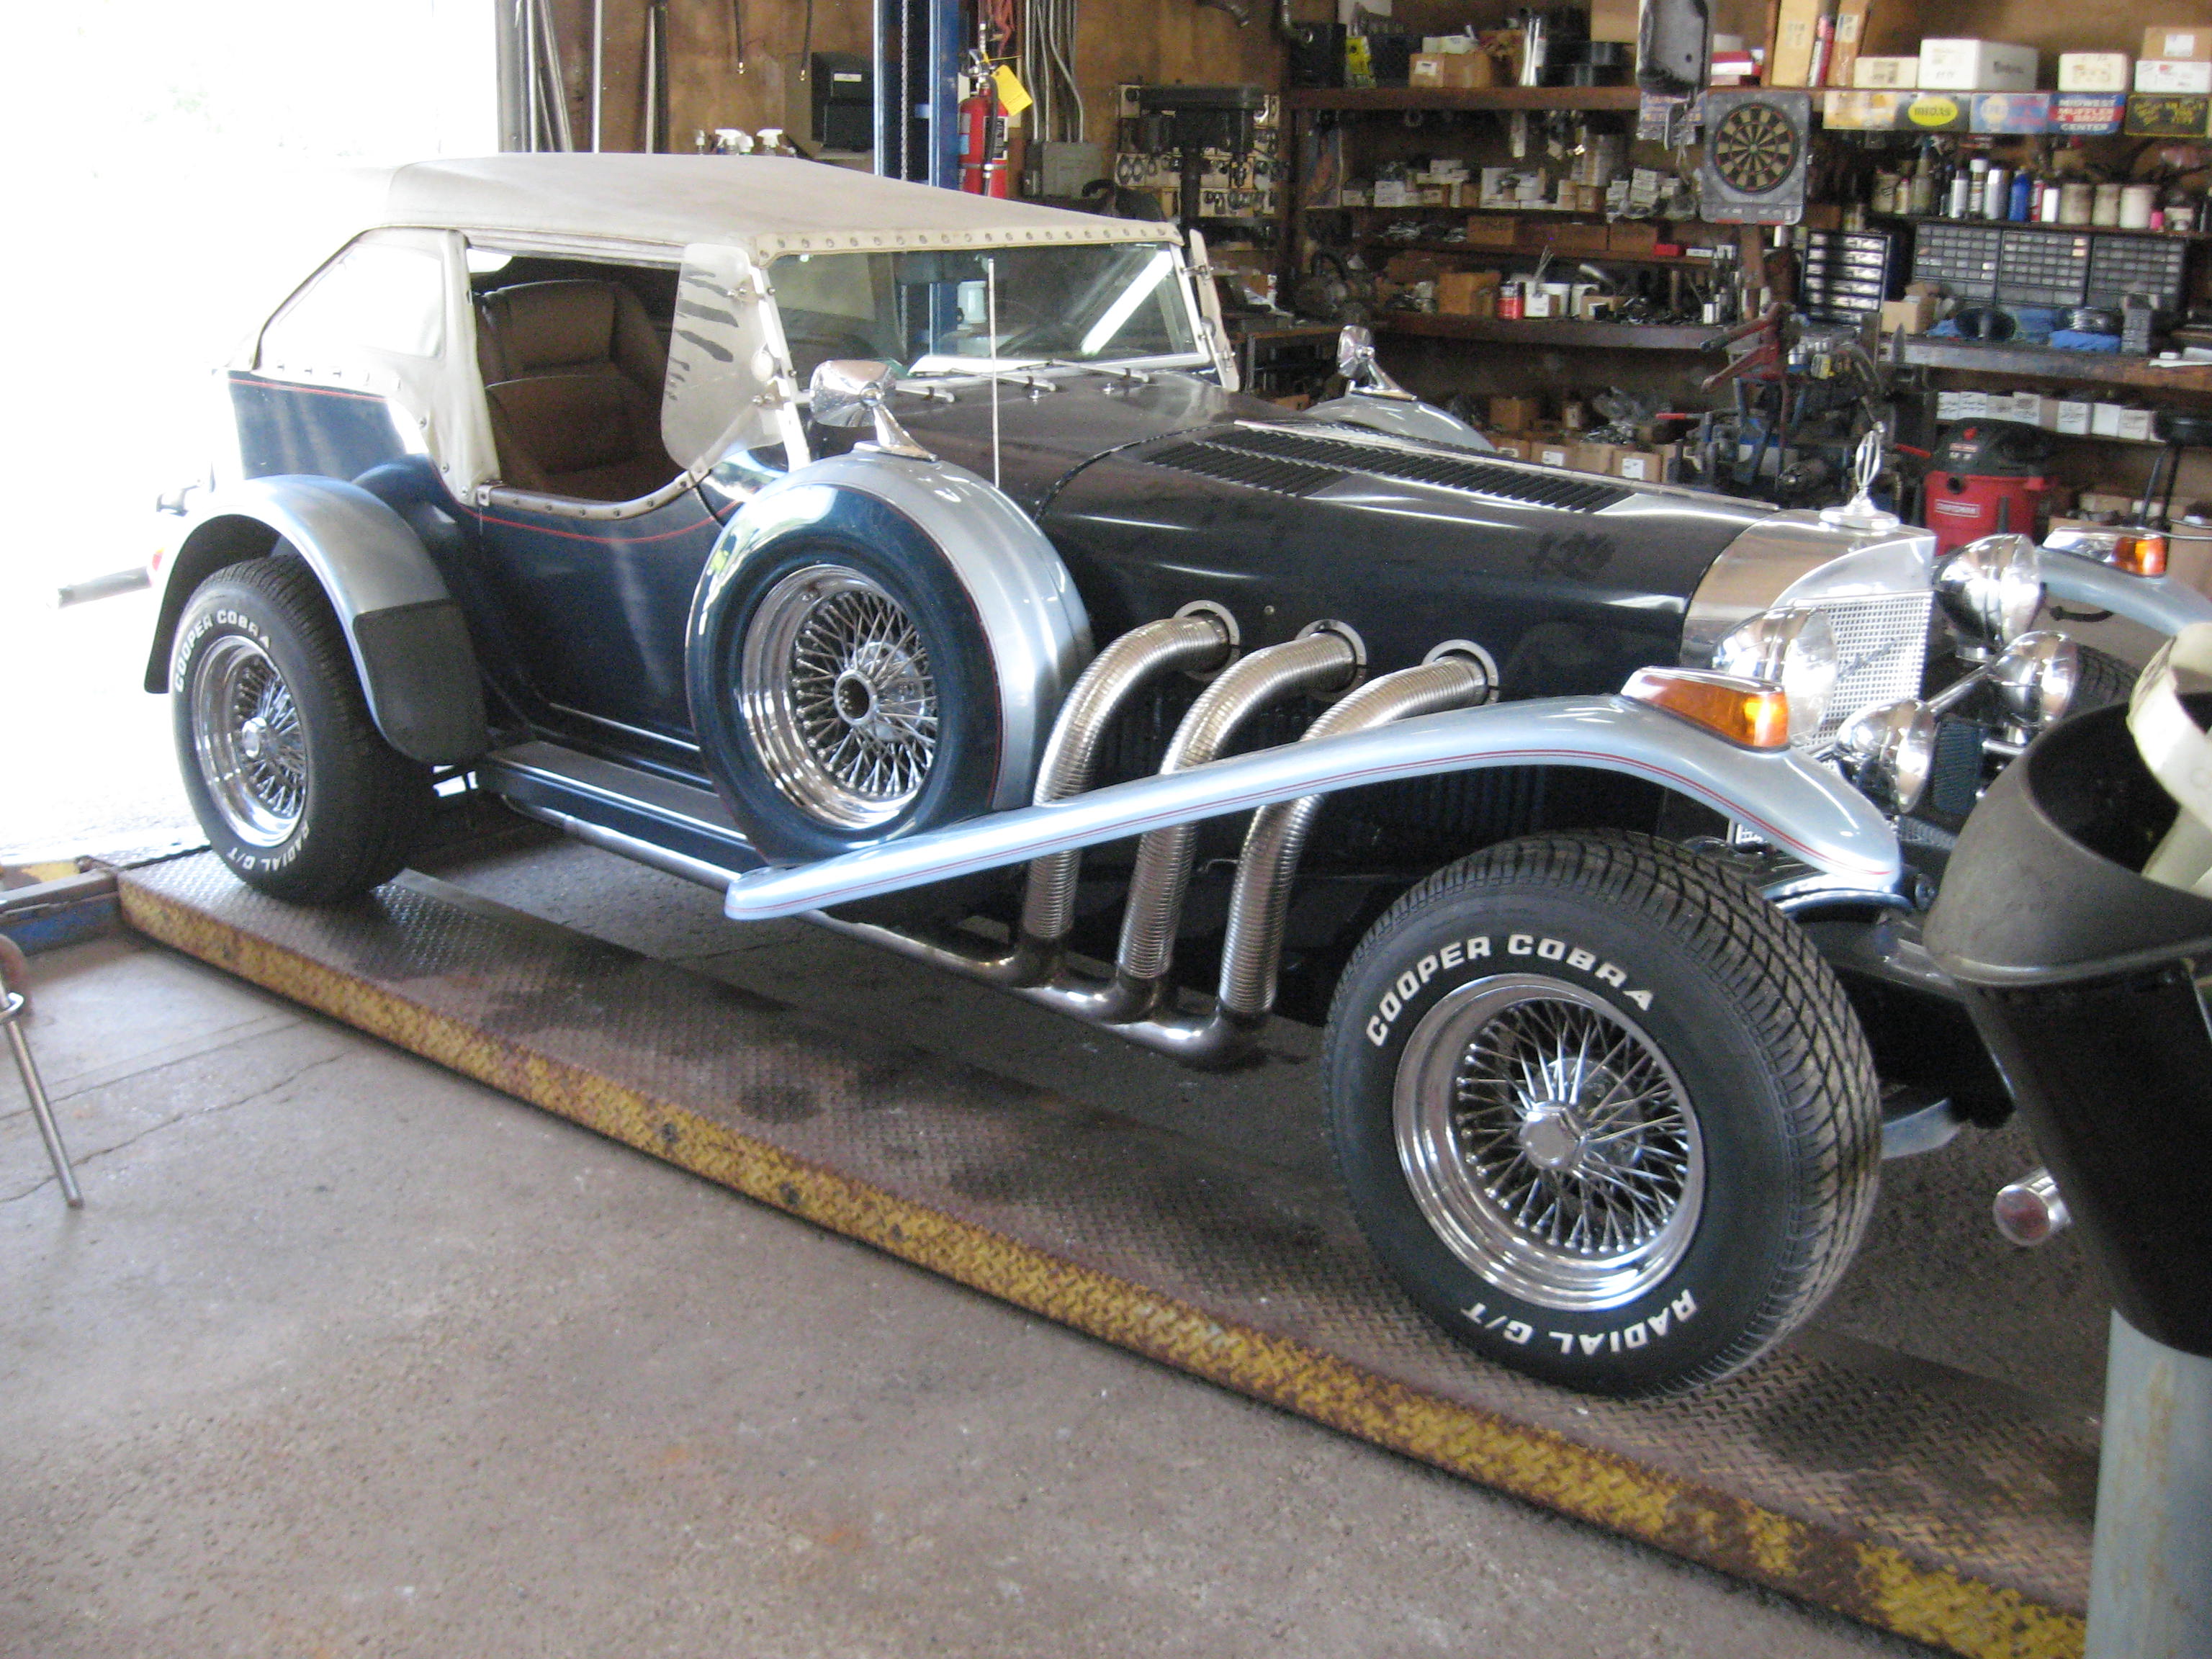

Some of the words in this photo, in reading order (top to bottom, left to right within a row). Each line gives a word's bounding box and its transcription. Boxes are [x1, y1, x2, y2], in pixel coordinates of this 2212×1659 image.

[174, 613, 214, 693] COOPER
[217, 609, 271, 649] COBRA
[261, 819, 310, 873] RADIAL
[1366, 935, 1491, 1047] COOPER
[1507, 934, 1654, 1012] COBRA
[1460, 1302, 1534, 1345] G/T
[1548, 1289, 1697, 1355] RADIAL
